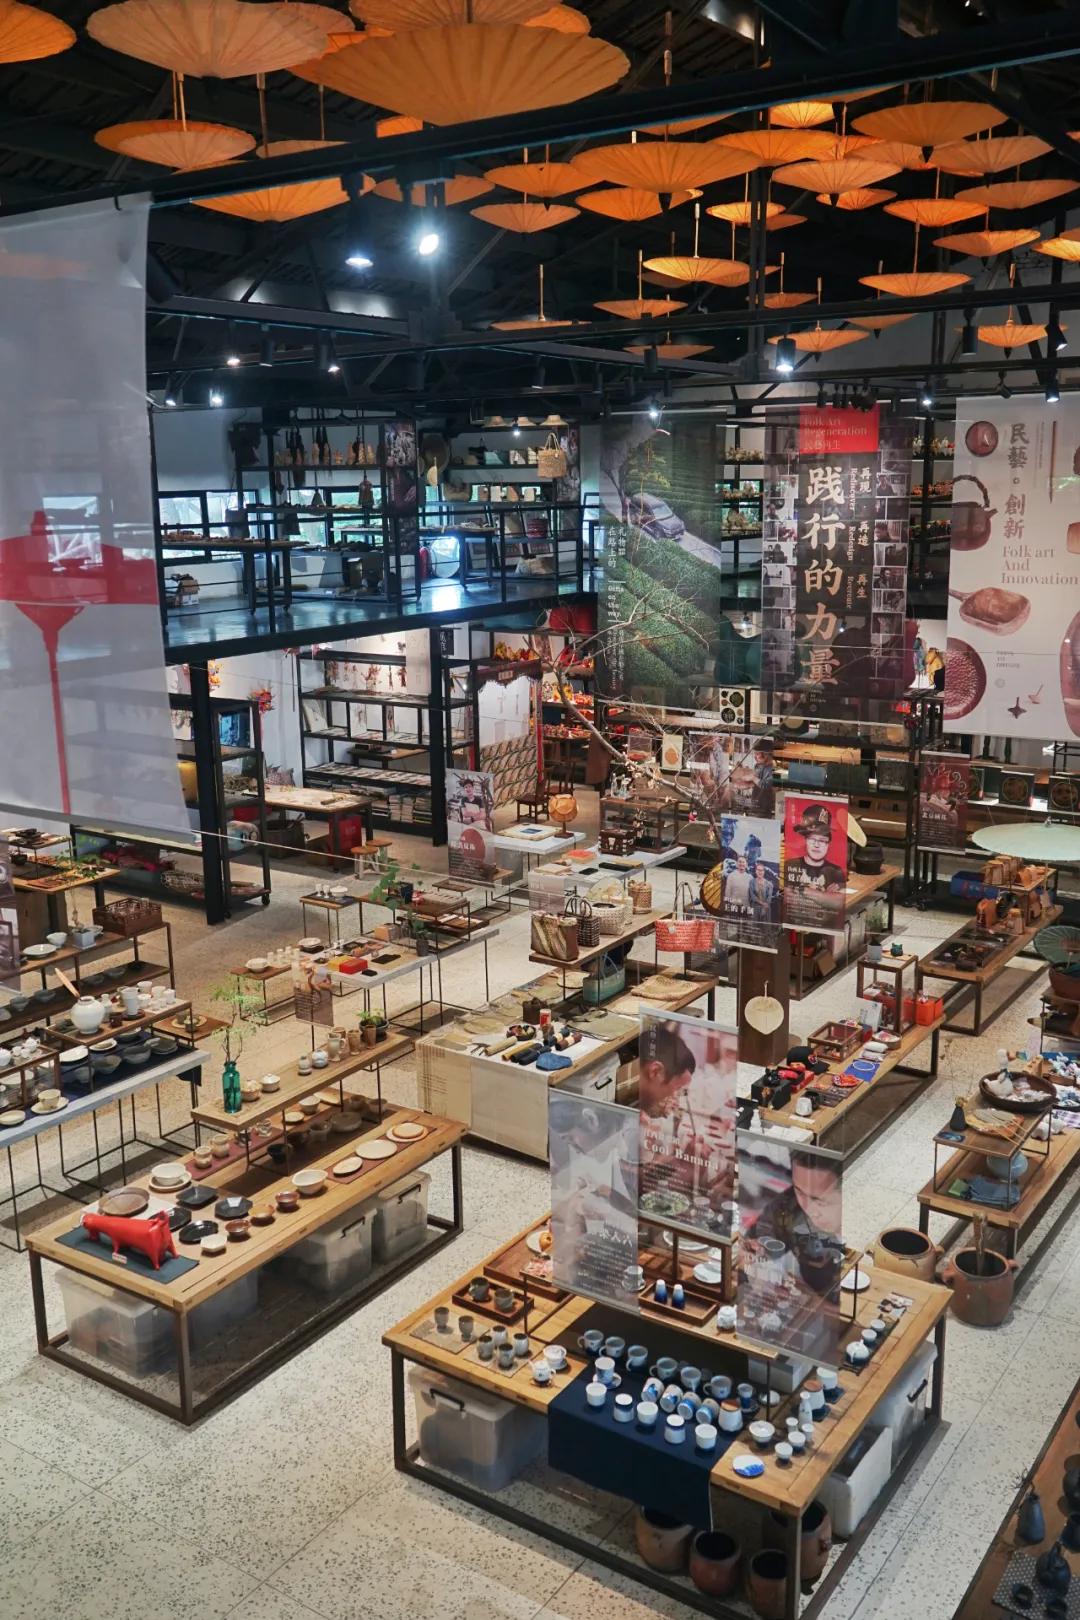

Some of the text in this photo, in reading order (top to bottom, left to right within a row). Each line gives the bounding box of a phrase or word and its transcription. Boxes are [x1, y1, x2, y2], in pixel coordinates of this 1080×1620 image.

[846, 526, 856, 561] Redesign
[1003, 545, 1055, 558] Folk art
[1003, 559, 1030, 571] And
[800, 465, 846, 686] 践行的力量
[1001, 573, 1079, 584] Innovation
[643, 1139, 670, 1156] Cool
